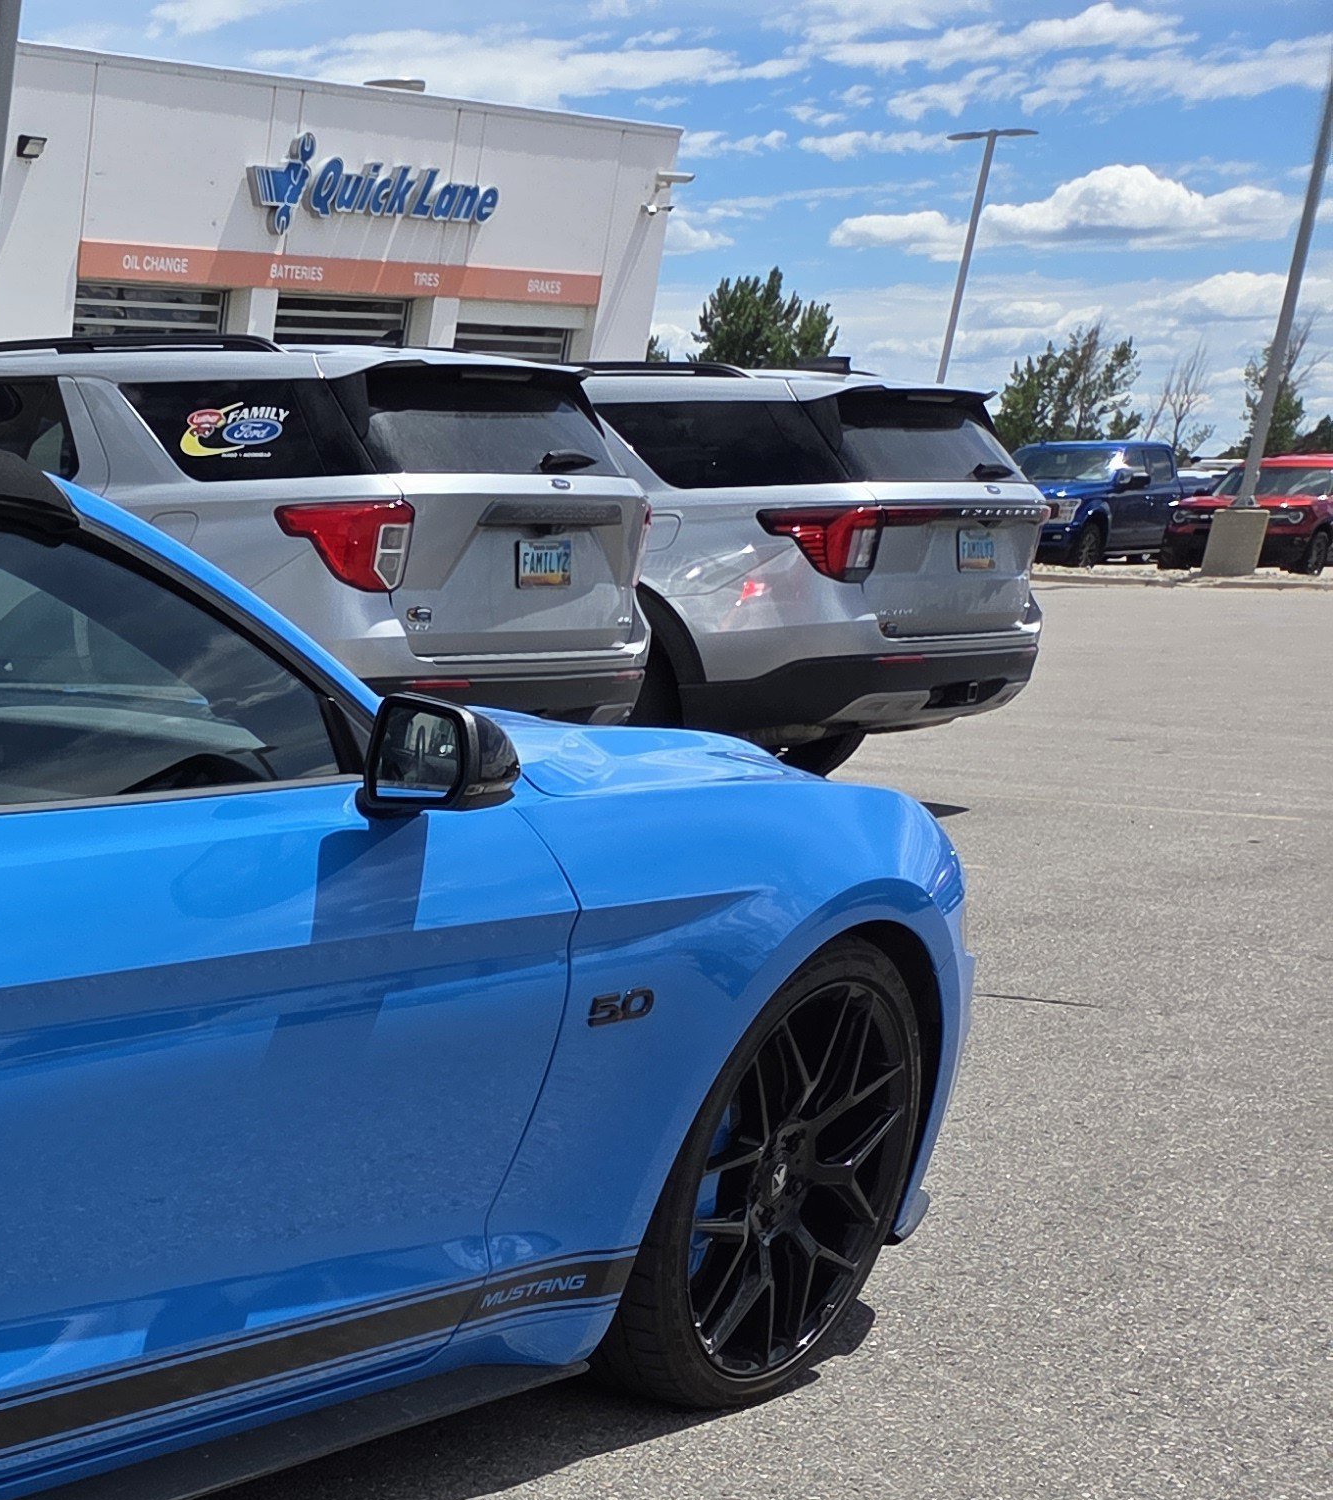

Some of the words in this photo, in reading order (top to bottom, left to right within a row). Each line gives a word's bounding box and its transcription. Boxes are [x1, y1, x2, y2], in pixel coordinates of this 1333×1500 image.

[313, 157, 415, 217] Quick
[411, 167, 499, 223] Lane
[122, 254, 141, 271] OIL
[142, 255, 189, 274] CHANGE
[269, 263, 324, 282] BATTERIES
[413, 272, 440, 288] TIRES
[527, 279, 562, 295] BRAKES
[227, 406, 290, 424] FAMILY
[234, 423, 270, 439] Ford
[522, 551, 570, 575] FAMILY2
[479, 1273, 587, 1310] MUSTANG
